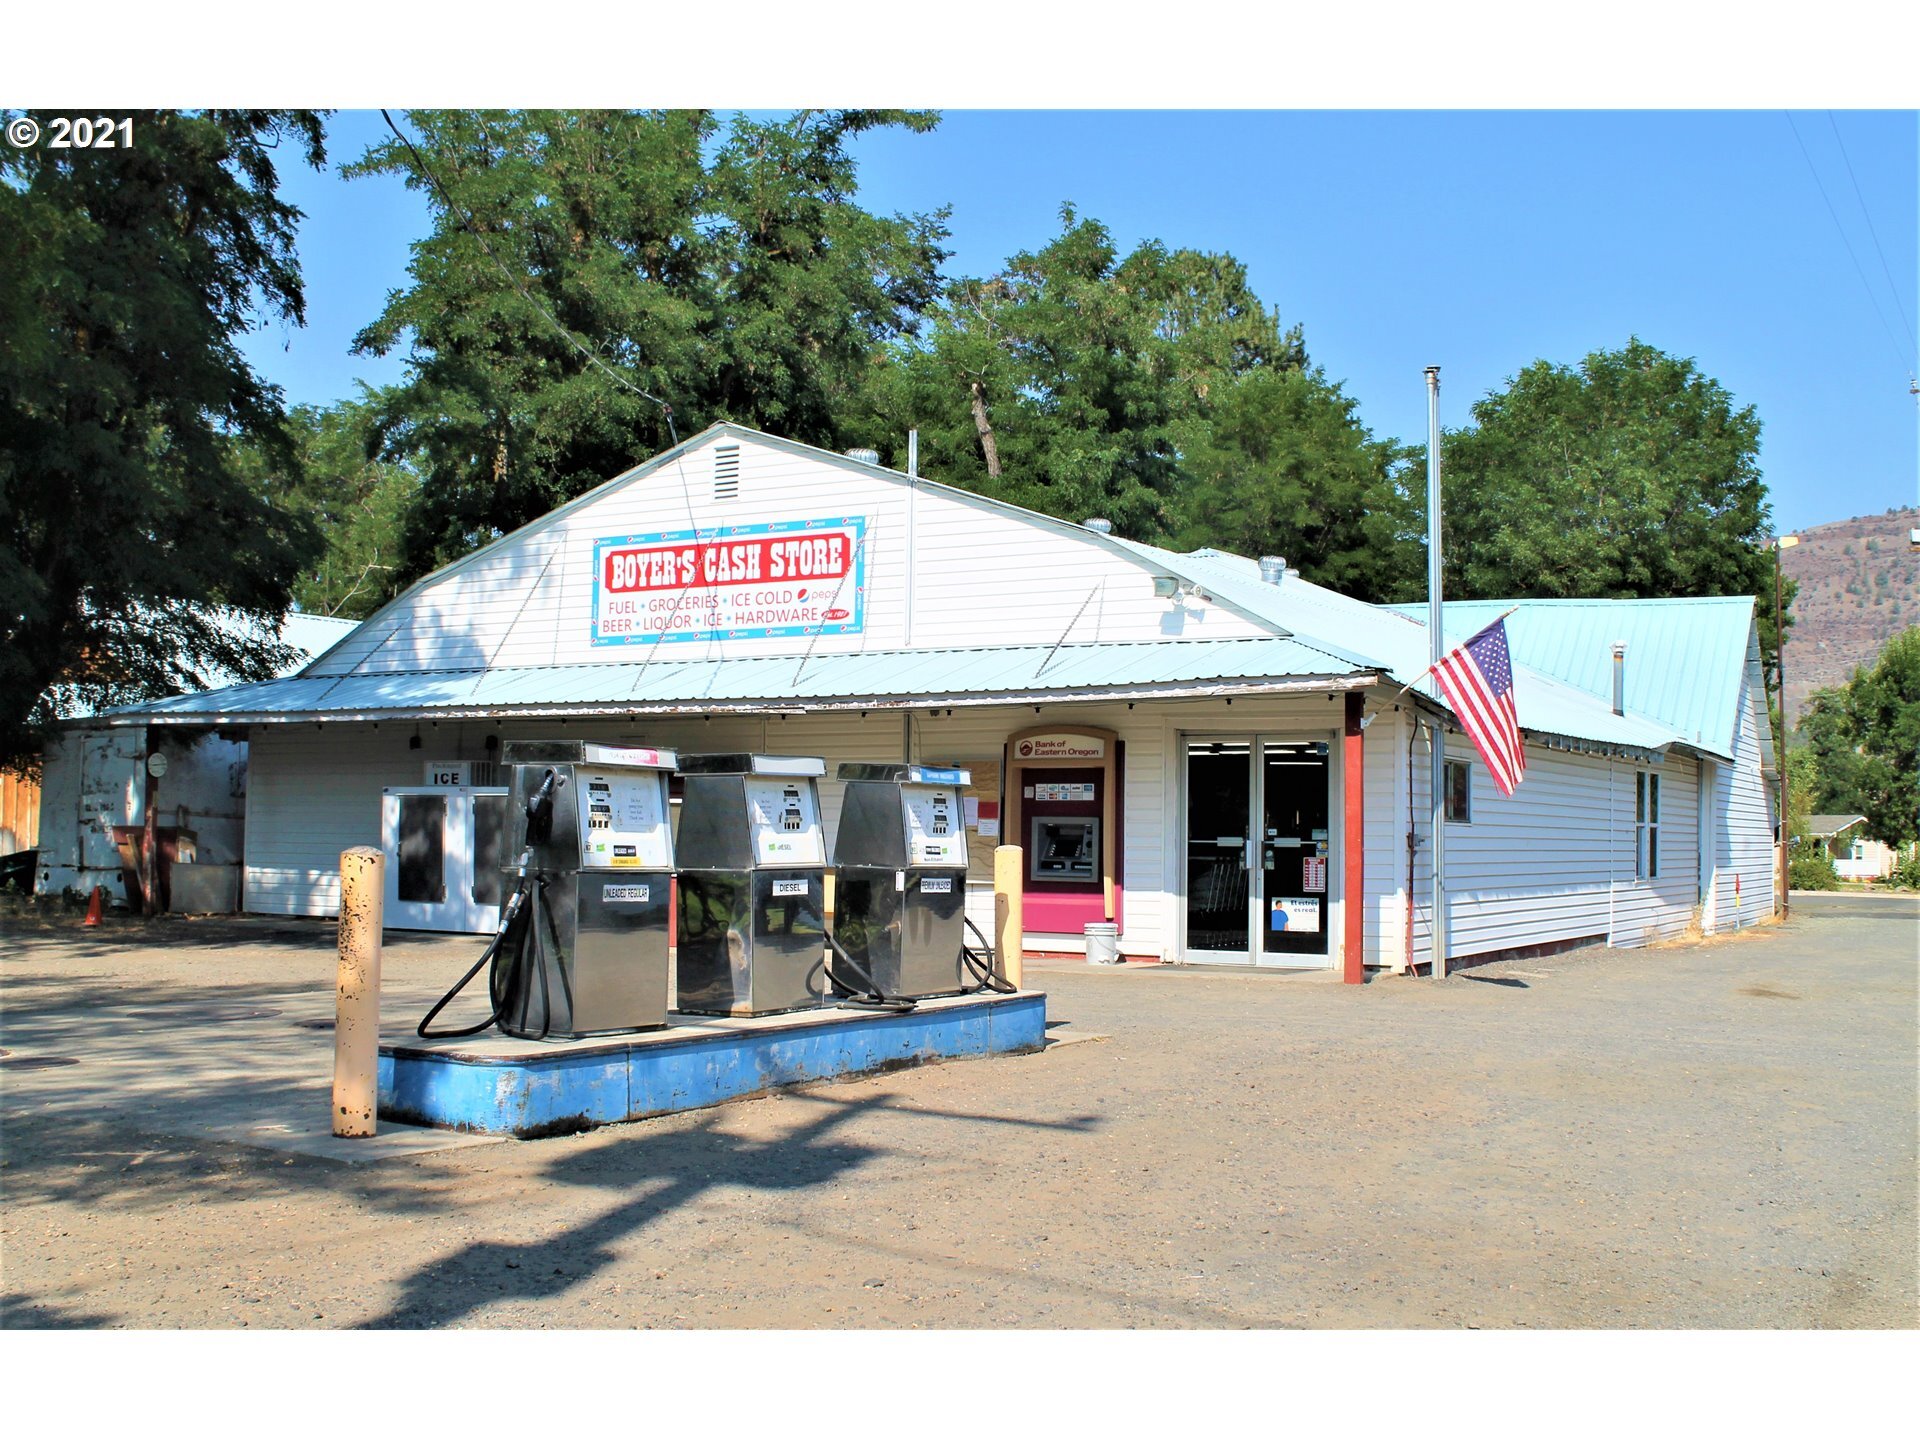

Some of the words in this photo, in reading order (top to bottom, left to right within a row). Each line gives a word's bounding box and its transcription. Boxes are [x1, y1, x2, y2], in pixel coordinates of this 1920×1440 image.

[612, 549, 696, 589] BOYER'S
[704, 544, 761, 583] CASH
[770, 538, 842, 577] STORE
[609, 601, 638, 614] FUEL
[649, 594, 719, 612] GROCERIES
[731, 593, 751, 606] ICE
[755, 590, 792, 605] COLD
[602, 619, 632, 632] BEER
[643, 615, 692, 630] LIQUOR
[704, 613, 723, 626] ICE
[735, 608, 818, 624] HARDWARE
[1035, 740, 1056, 748] Bank
[1057, 740, 1066, 748] of
[1035, 748, 1067, 756] Eastern
[1068, 748, 1099, 757] Oregon
[434, 772, 459, 785] ICE
[604, 888, 627, 898] UNLEADED
[628, 888, 647, 898] REGULAR
[779, 883, 801, 892] DIESEL
